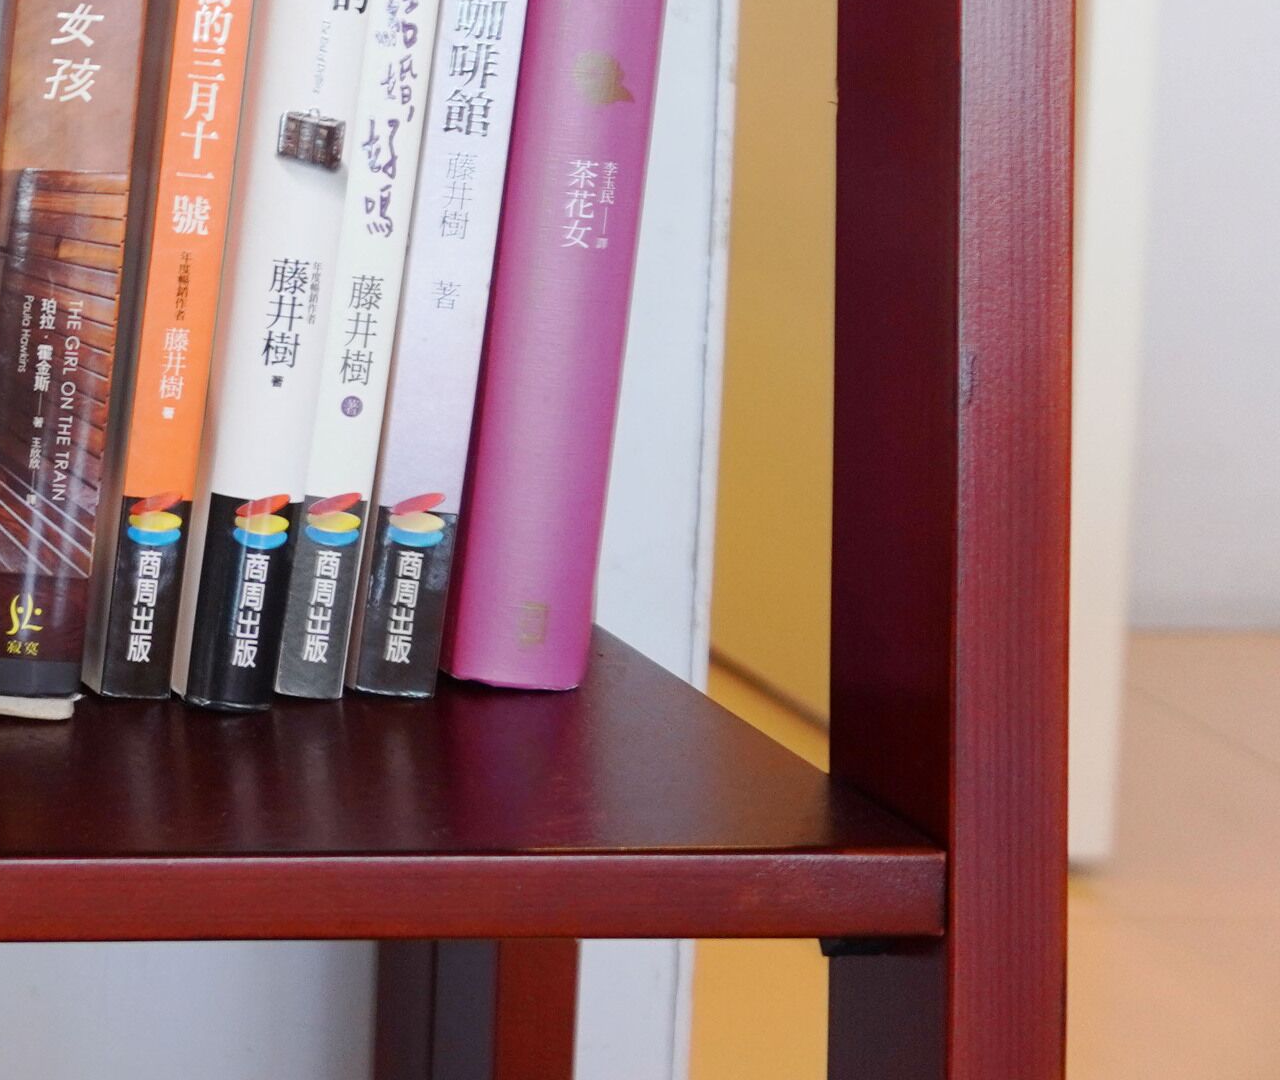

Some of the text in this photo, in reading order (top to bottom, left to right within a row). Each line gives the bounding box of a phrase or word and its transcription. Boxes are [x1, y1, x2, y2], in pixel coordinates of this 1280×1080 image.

[431, 151, 479, 310] 藤井樹 著
[560, 158, 600, 250] 茶花女
[599, 161, 619, 205] 李玉民
[17, 294, 35, 374] Paula Hawkins
[159, 327, 191, 401] 藤井樹
[261, 257, 310, 369] 藤井樹
[339, 273, 385, 387] 藤井樹
[51, 299, 84, 502] THE GIRL ON THE TRAIN
[126, 549, 164, 664] 商周出版
[231, 553, 271, 669] 商周出版
[302, 549, 342, 664] 商周出版
[385, 549, 425, 665] 商周出版
